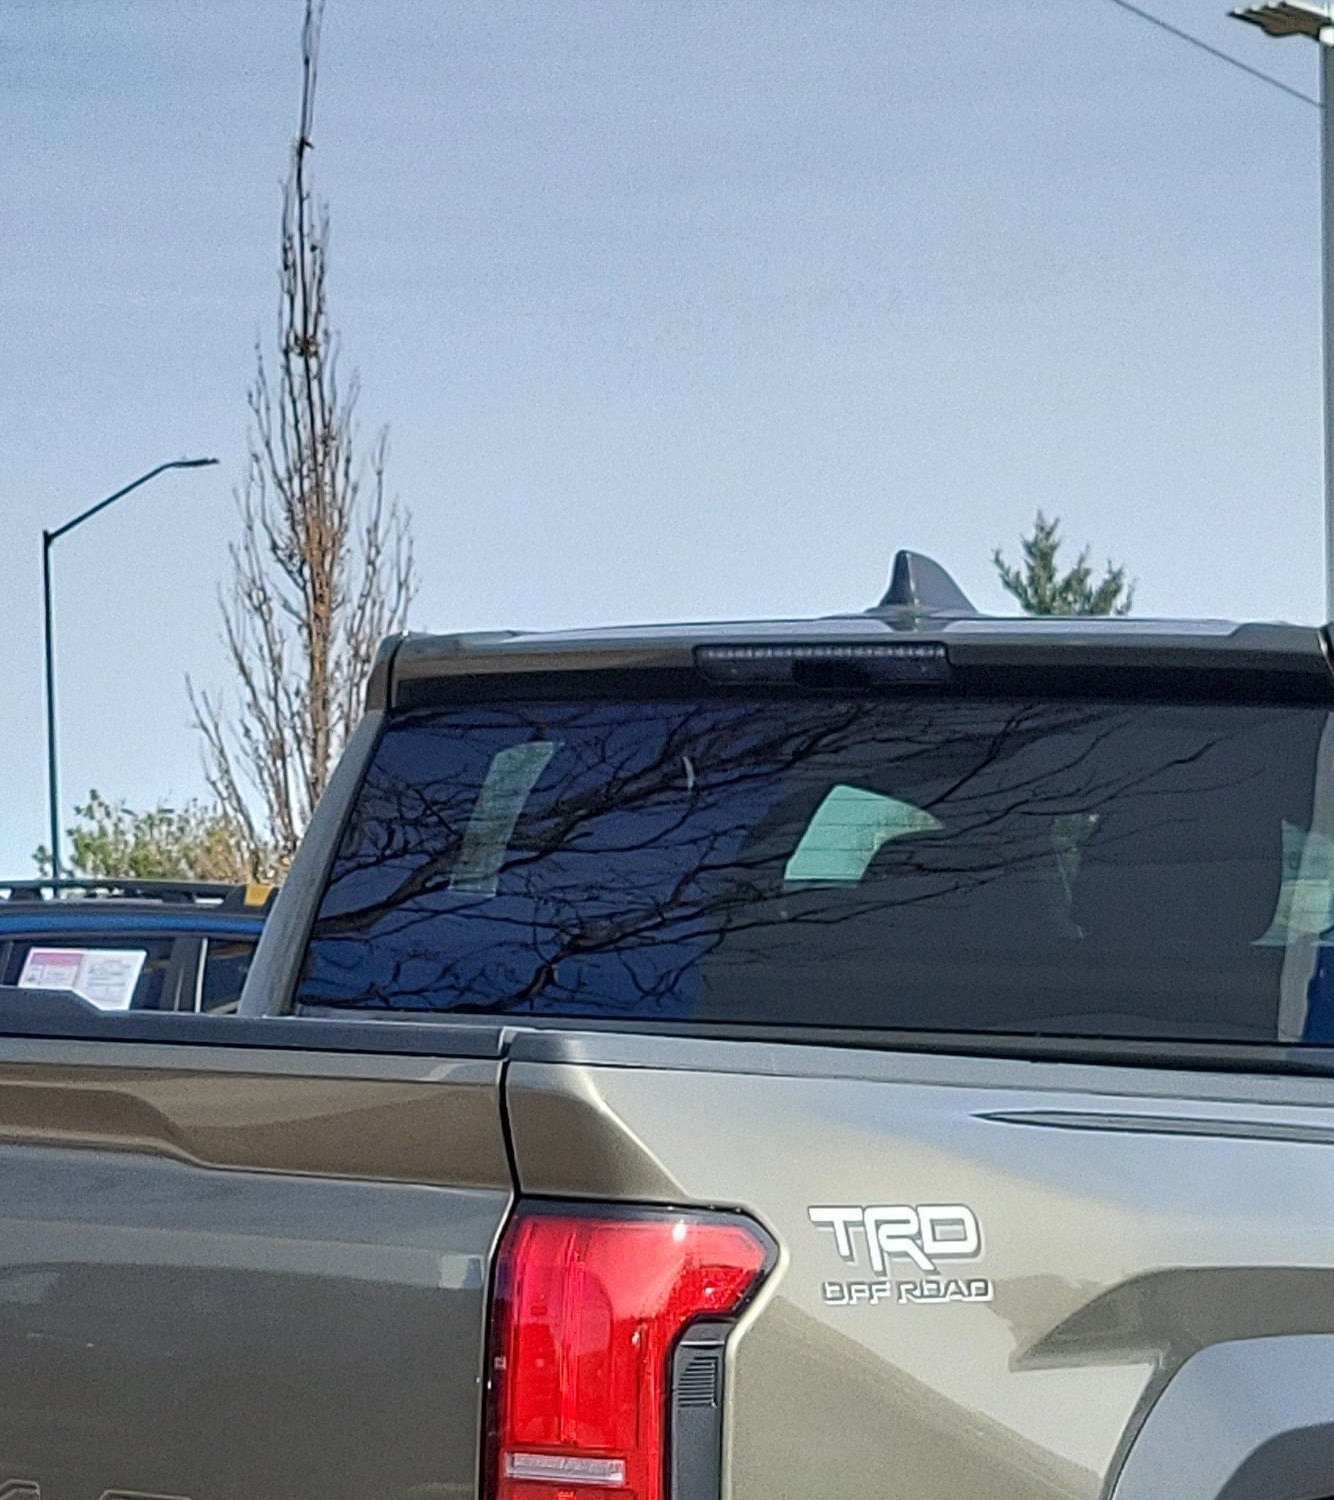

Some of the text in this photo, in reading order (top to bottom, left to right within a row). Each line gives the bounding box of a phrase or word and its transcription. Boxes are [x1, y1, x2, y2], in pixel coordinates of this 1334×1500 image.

[807, 1203, 982, 1276] TRD
[823, 1278, 994, 1305] OFF ROAD
